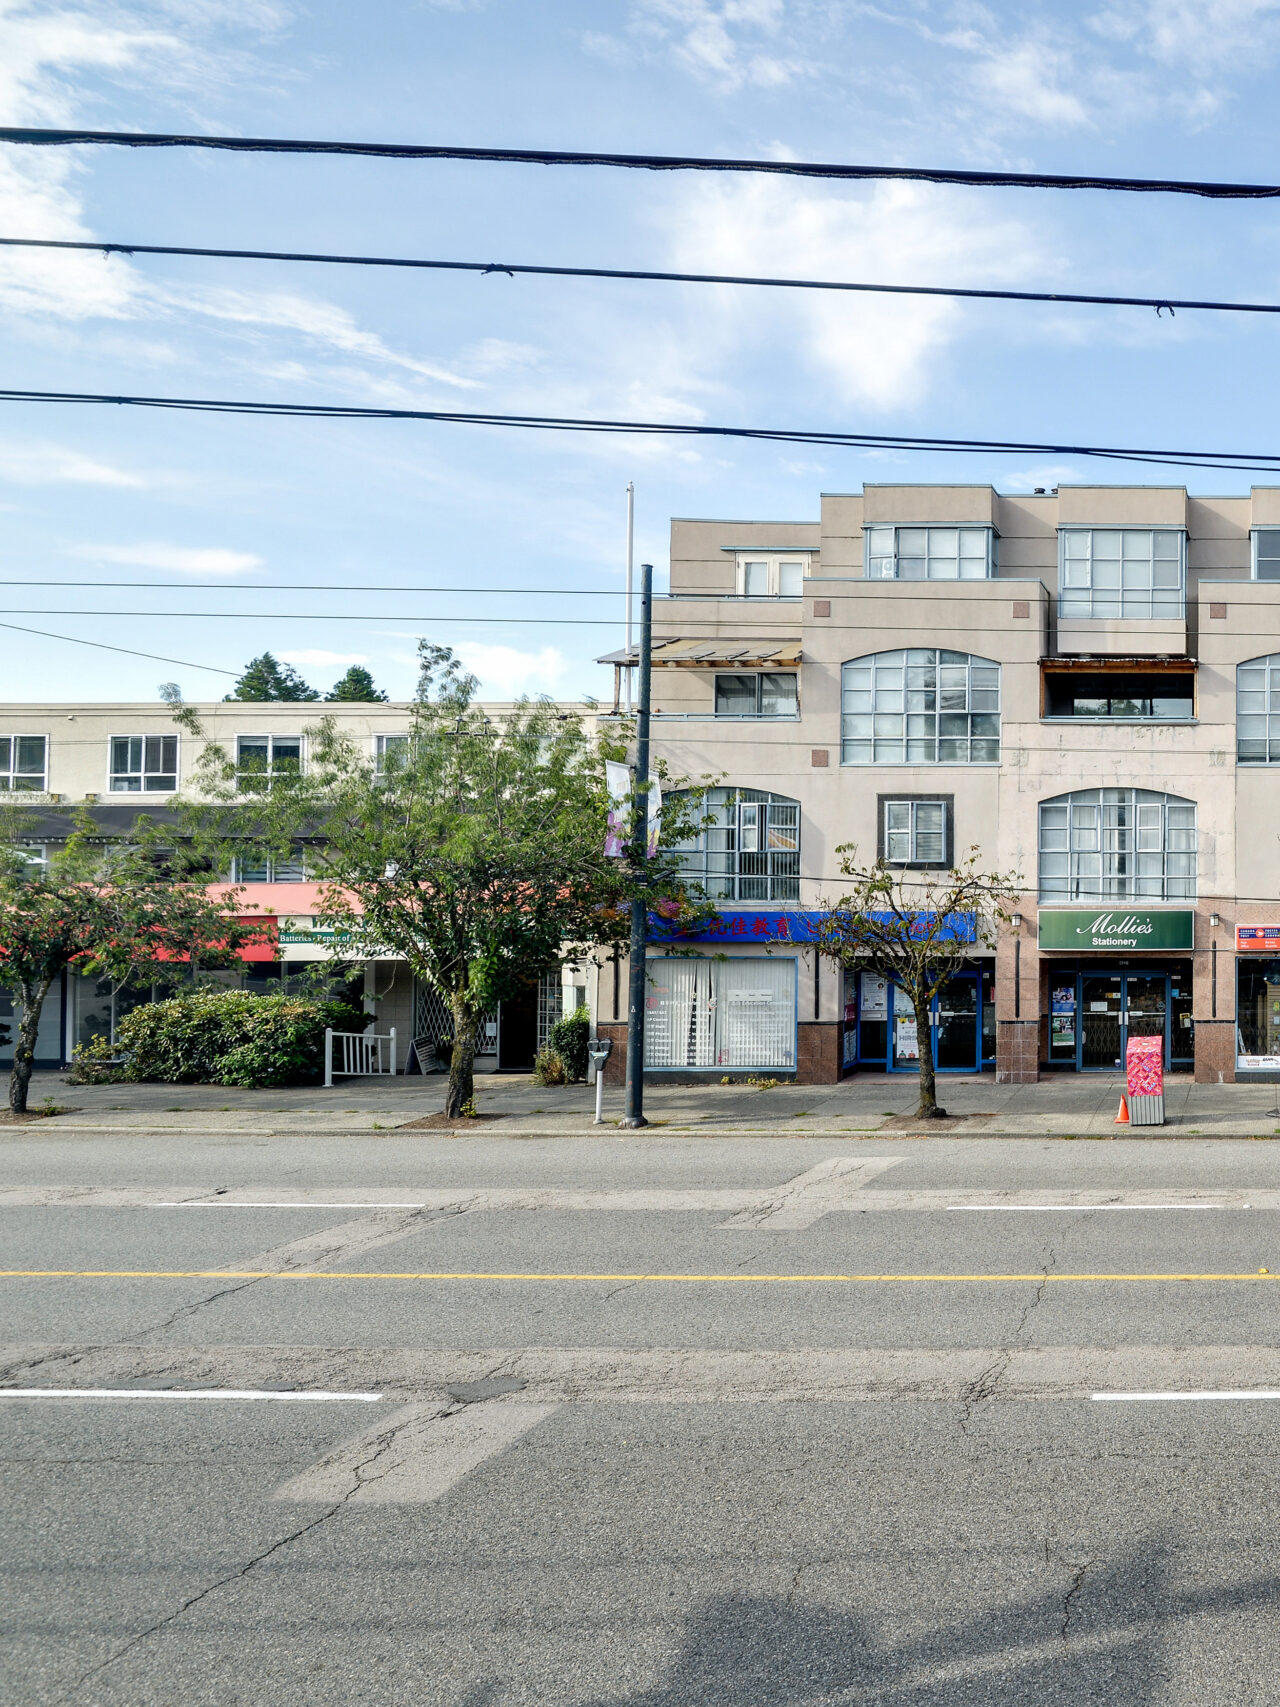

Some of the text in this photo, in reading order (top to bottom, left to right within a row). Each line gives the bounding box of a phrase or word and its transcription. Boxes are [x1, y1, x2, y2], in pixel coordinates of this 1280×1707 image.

[1076, 913, 1154, 934] Mollie's
[342, 934, 351, 942] of
[1092, 937, 1137, 947] Stationery
